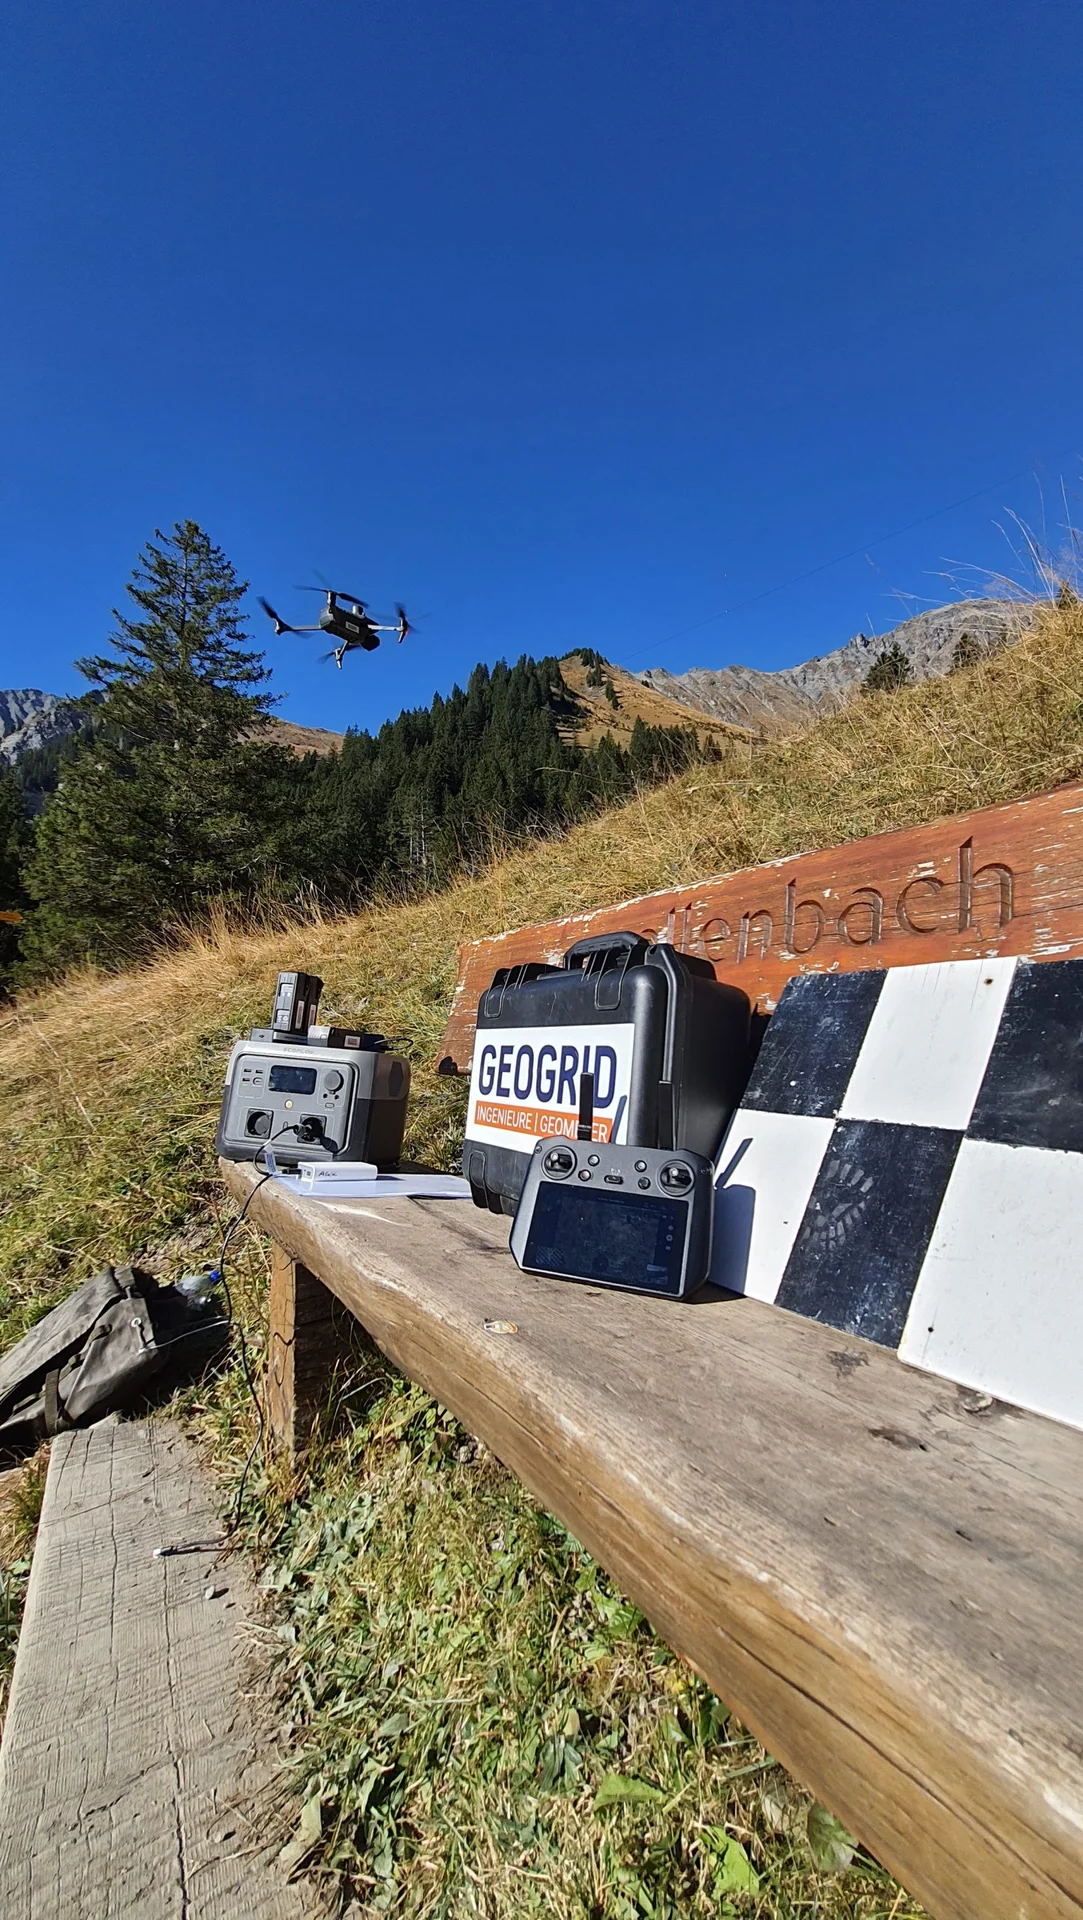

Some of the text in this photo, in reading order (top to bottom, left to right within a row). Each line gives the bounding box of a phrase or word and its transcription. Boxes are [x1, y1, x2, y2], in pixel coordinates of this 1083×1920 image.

[641, 835, 1014, 964] llenbach
[477, 1105, 532, 1130] INGENIEURE
[540, 1115, 609, 1143] GEOMER
